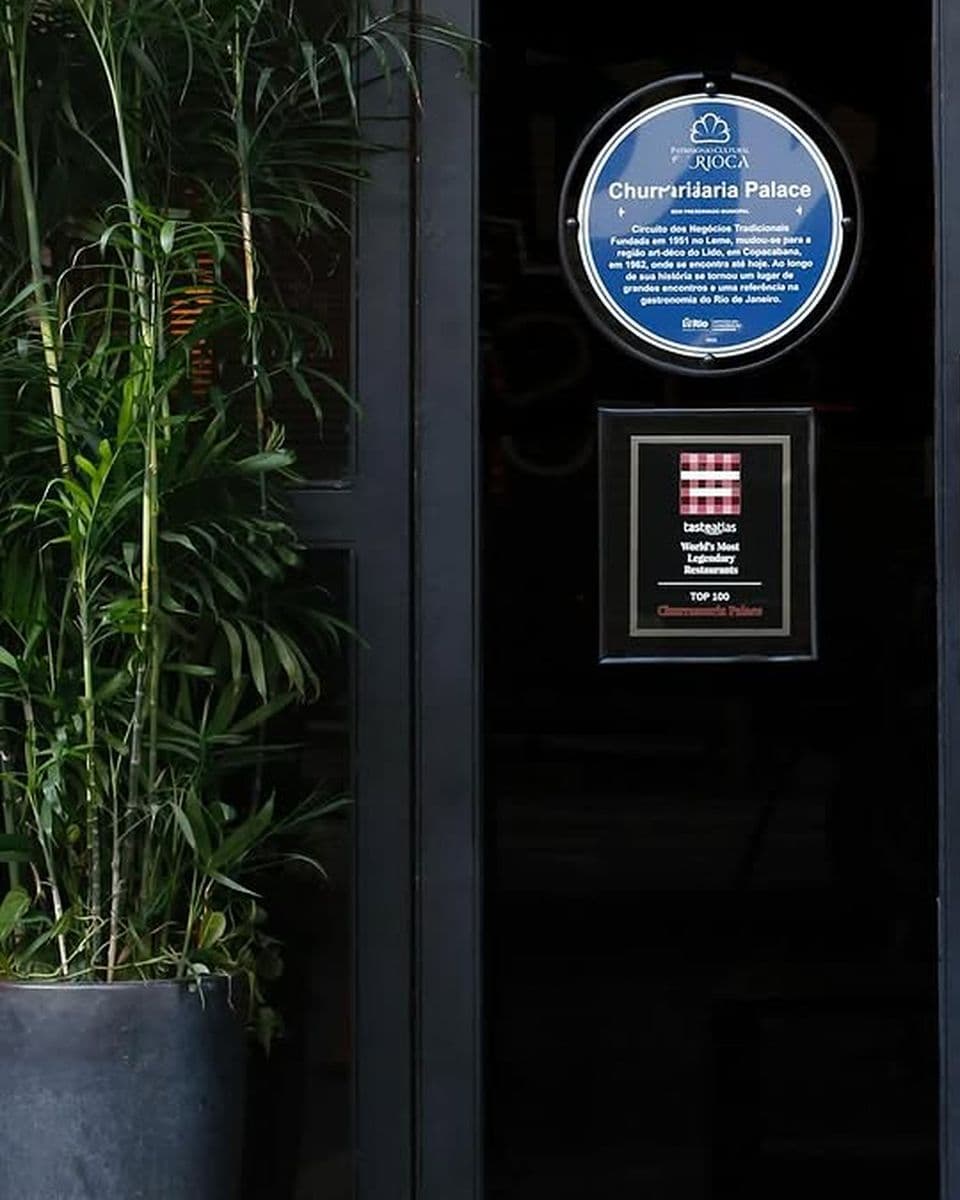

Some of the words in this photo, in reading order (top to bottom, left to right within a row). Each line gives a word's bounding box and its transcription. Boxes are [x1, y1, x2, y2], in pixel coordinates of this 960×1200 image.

[744, 181, 812, 199] Palace
[631, 225, 668, 234] Circuito
[670, 225, 686, 234] dos
[689, 224, 732, 235] Negócios
[735, 224, 789, 233] Tradicionais
[610, 236, 649, 245] Fundada
[691, 237, 704, 245] no
[736, 236, 781, 244] mudou-se
[617, 248, 645, 259] região
[743, 248, 802, 257] Copacabana,
[650, 260, 674, 269] onde
[689, 260, 729, 269] encontra
[772, 259, 785, 267] Ao
[787, 259, 814, 269] longo
[625, 272, 637, 280] de
[658, 272, 692, 280] história
[707, 272, 738, 280] tornou
[756, 271, 781, 281] lugar
[782, 271, 794, 279] de
[623, 284, 660, 294] grandes
[662, 284, 708, 292] encontros
[740, 283, 785, 291] referência
[640, 296, 697, 306] gastronomia
[699, 296, 712, 304] do
[714, 295, 729, 304] Rio
[731, 295, 742, 303] de
[745, 295, 782, 304] Janeiro.
[687, 554, 736, 564] Legendary
[683, 565, 739, 575] Restaurants
[689, 591, 710, 601] TOP
[712, 591, 730, 601] 100
